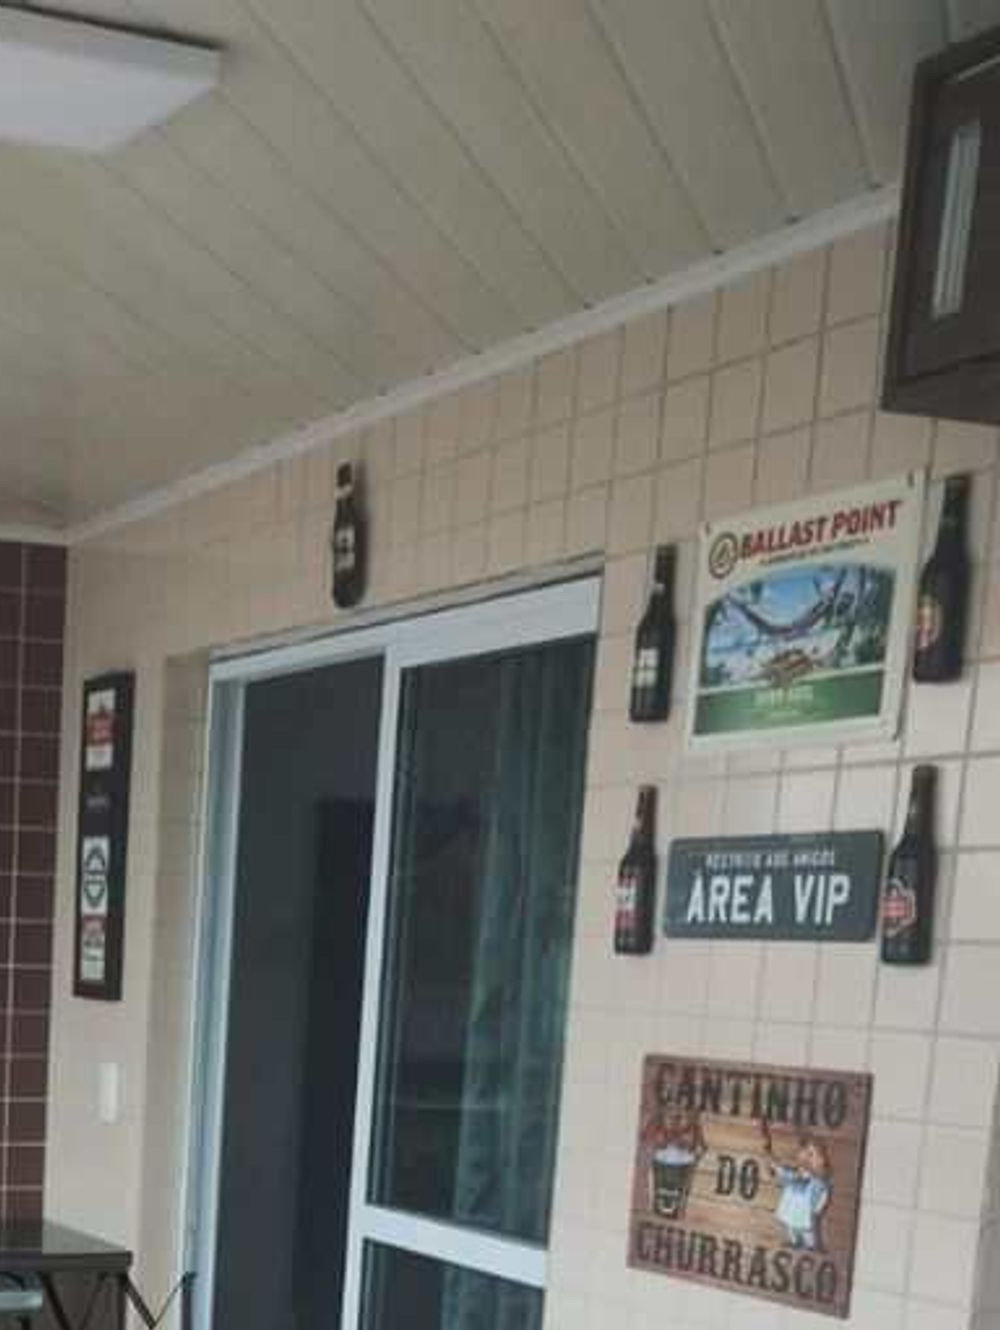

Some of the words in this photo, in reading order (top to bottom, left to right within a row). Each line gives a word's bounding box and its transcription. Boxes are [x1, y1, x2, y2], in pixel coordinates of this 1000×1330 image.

[741, 517, 827, 558] BALLAST
[831, 500, 902, 538] POINT
[794, 874, 850, 924] VIP
[655, 1063, 847, 1128] CANTINHO
[716, 1155, 760, 1200] DO
[637, 1222, 838, 1303] CHURRASCO
